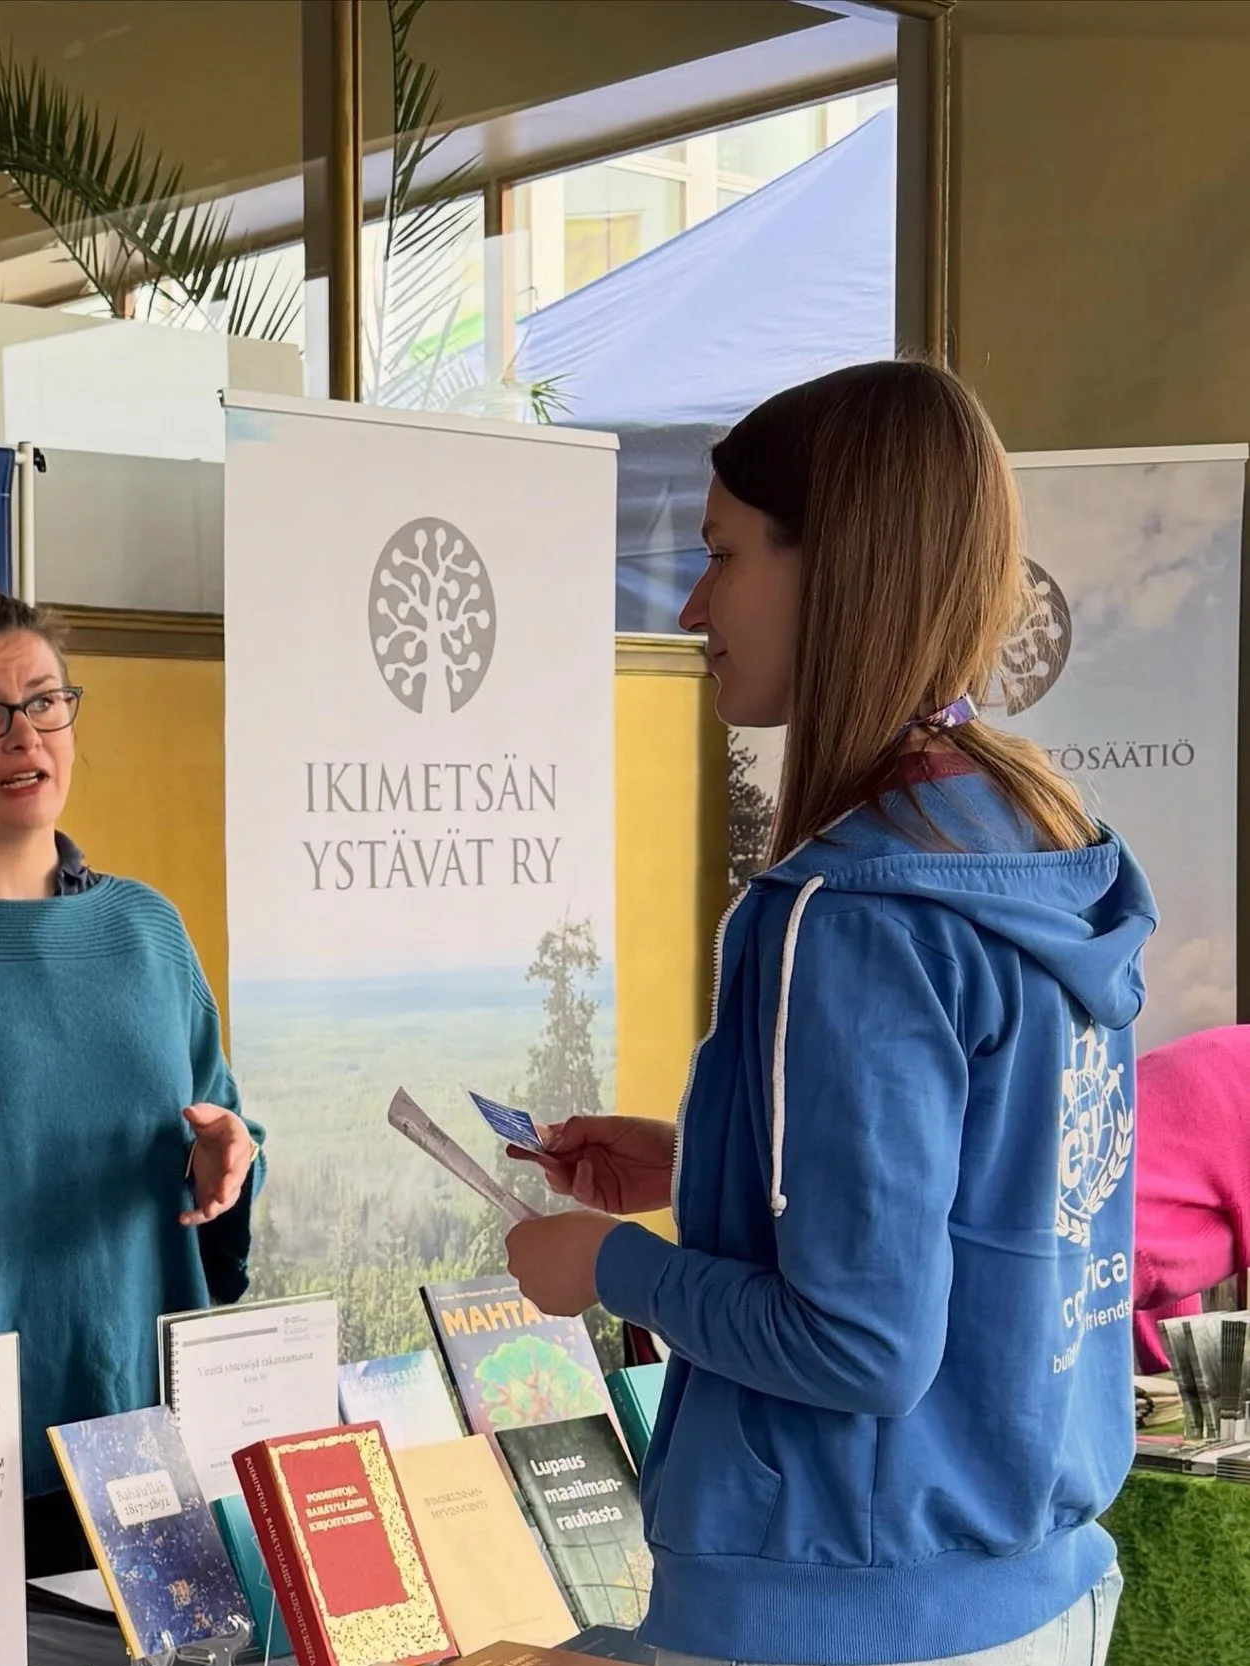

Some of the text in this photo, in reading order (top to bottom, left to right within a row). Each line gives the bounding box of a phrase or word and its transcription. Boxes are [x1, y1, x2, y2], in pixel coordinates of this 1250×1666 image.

[304, 754, 558, 814] IKIMETSÄN
[301, 829, 562, 892] YSTÄVÄT RY
[440, 1298, 564, 1337] MAHTA
[530, 1455, 586, 1477] Lupaus
[305, 1485, 358, 1503] POIMINTOJA
[543, 1478, 622, 1504] maailman-
[556, 1505, 623, 1531] rauhasta
[244, 1456, 269, 1514] POIMINTOJA
[290, 1591, 317, 1666] KIRJOITUKSISTA
